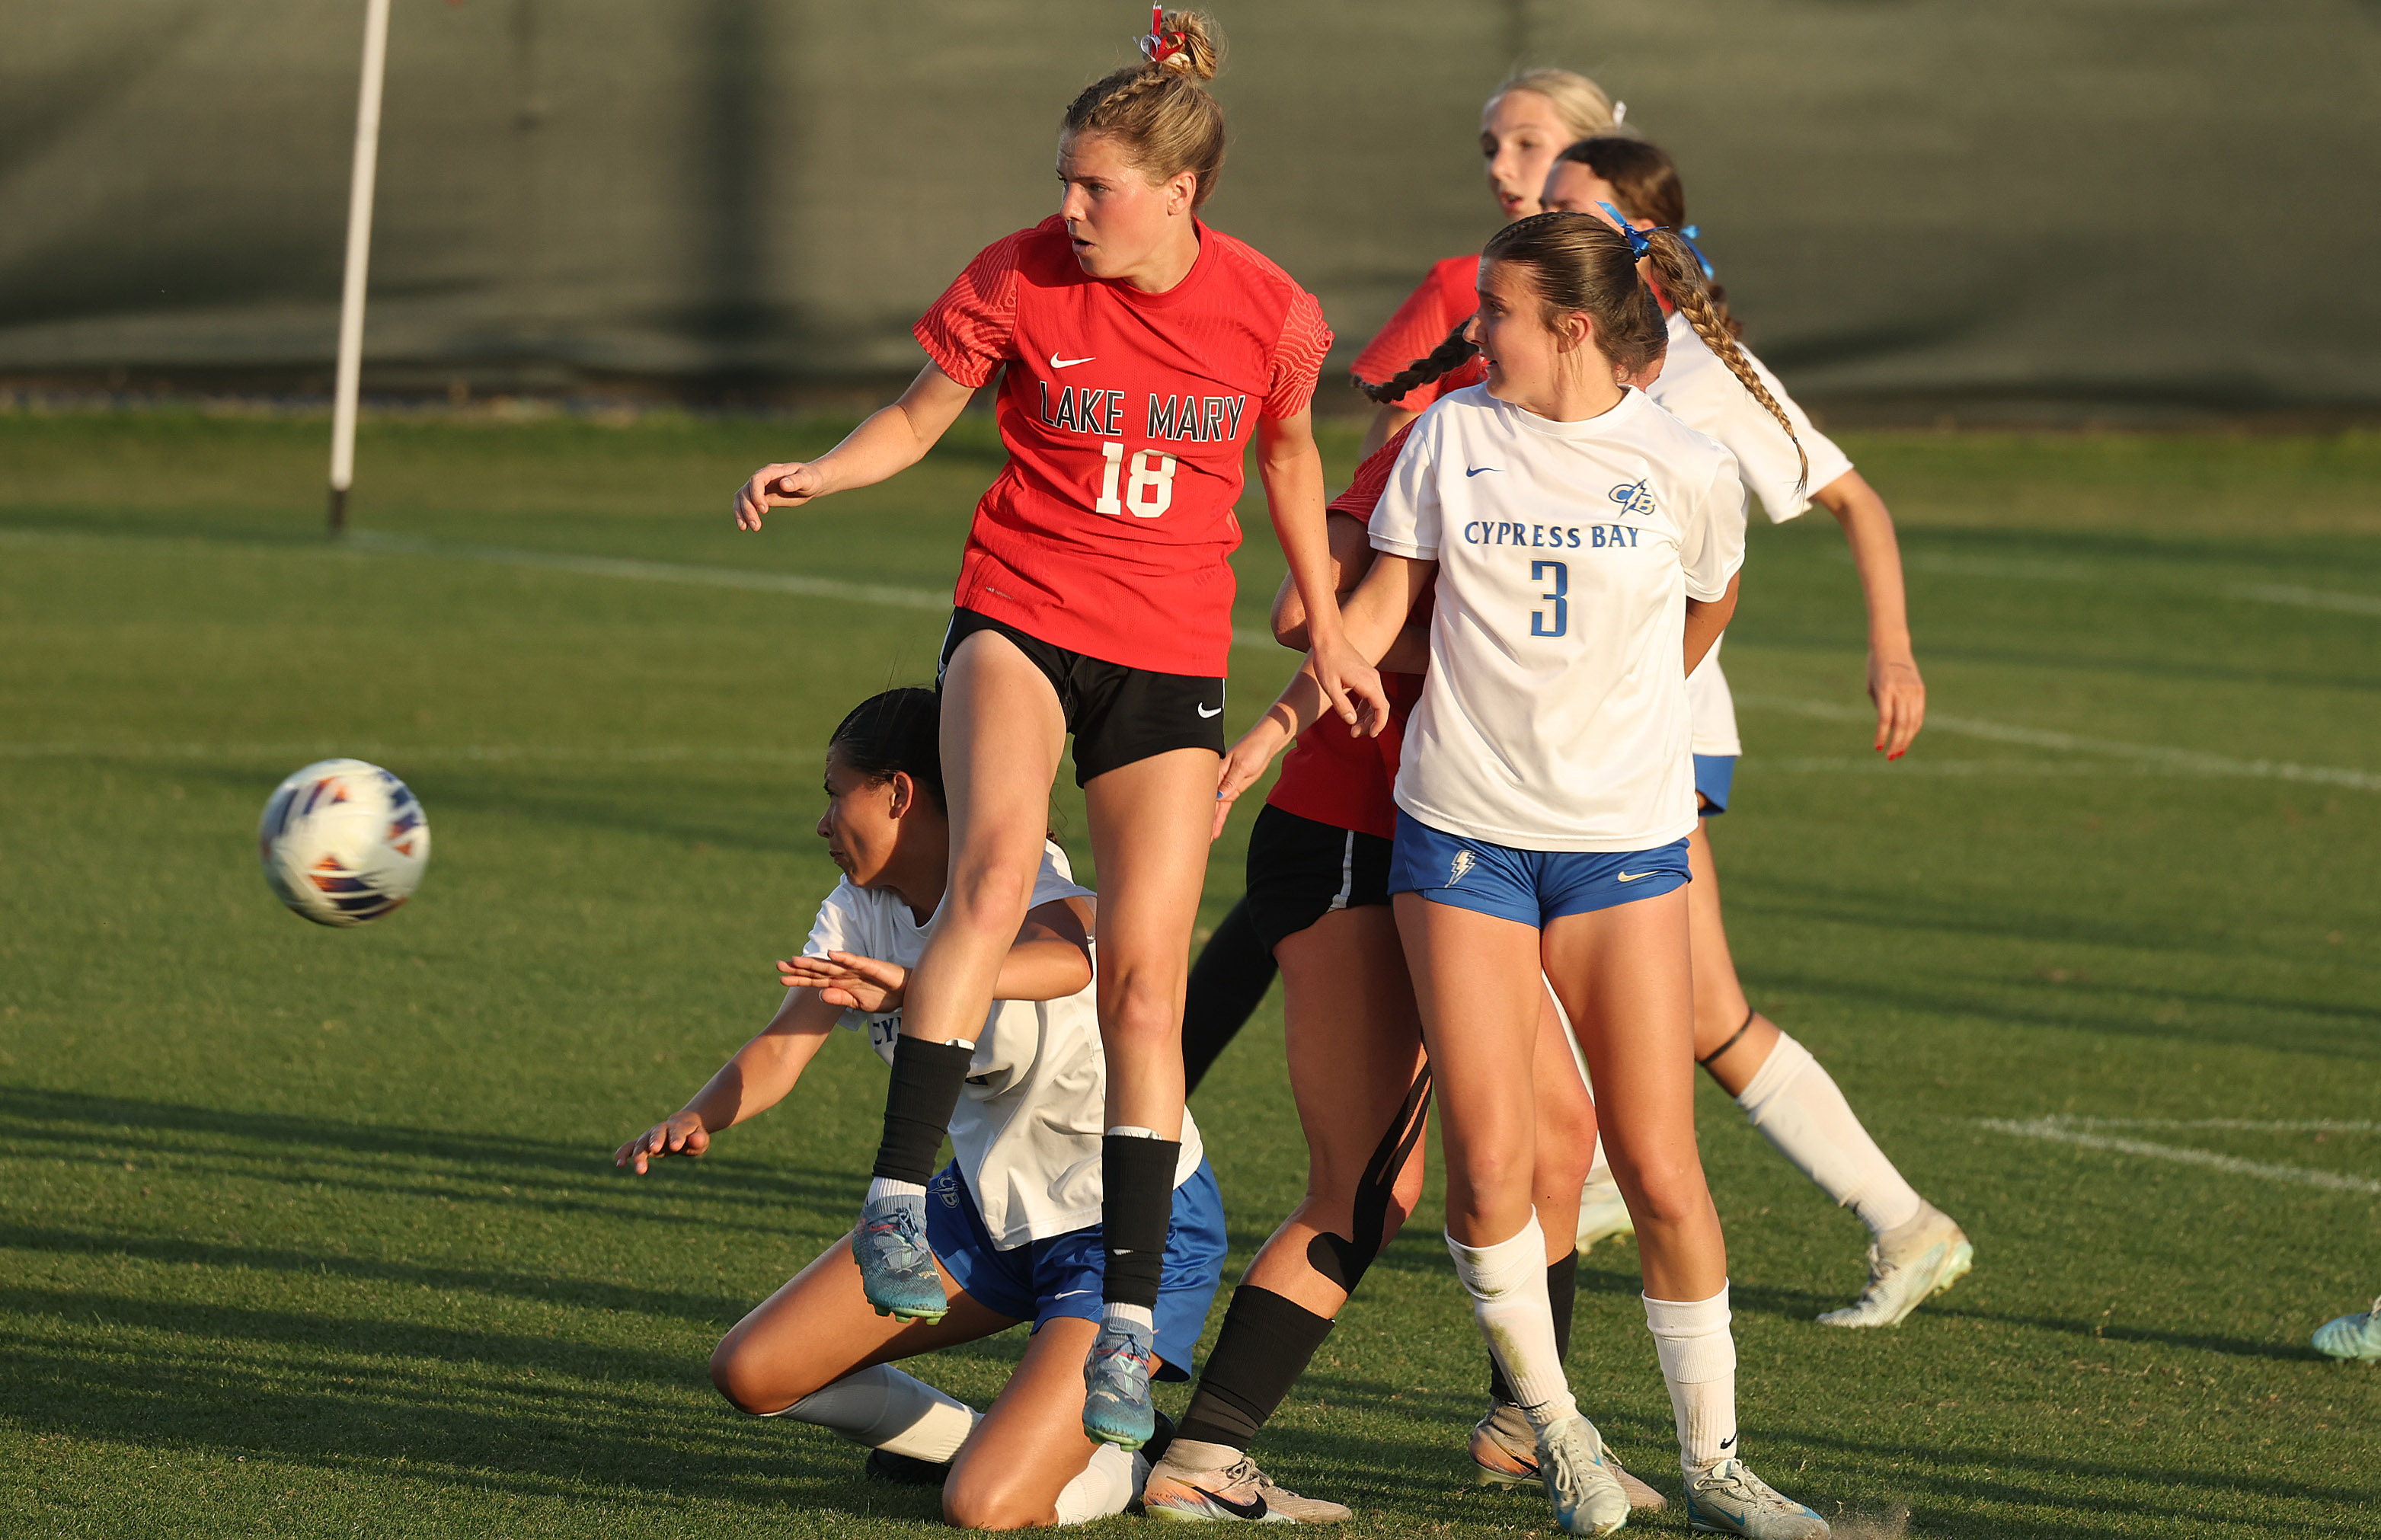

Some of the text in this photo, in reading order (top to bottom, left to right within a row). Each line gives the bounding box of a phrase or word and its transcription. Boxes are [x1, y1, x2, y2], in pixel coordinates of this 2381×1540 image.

[1040, 381, 1246, 443] LAKE MARY
[1095, 441, 1178, 518] 18
[1464, 521, 1639, 548] CYPRESS BAY
[1529, 558, 1571, 640] 3
